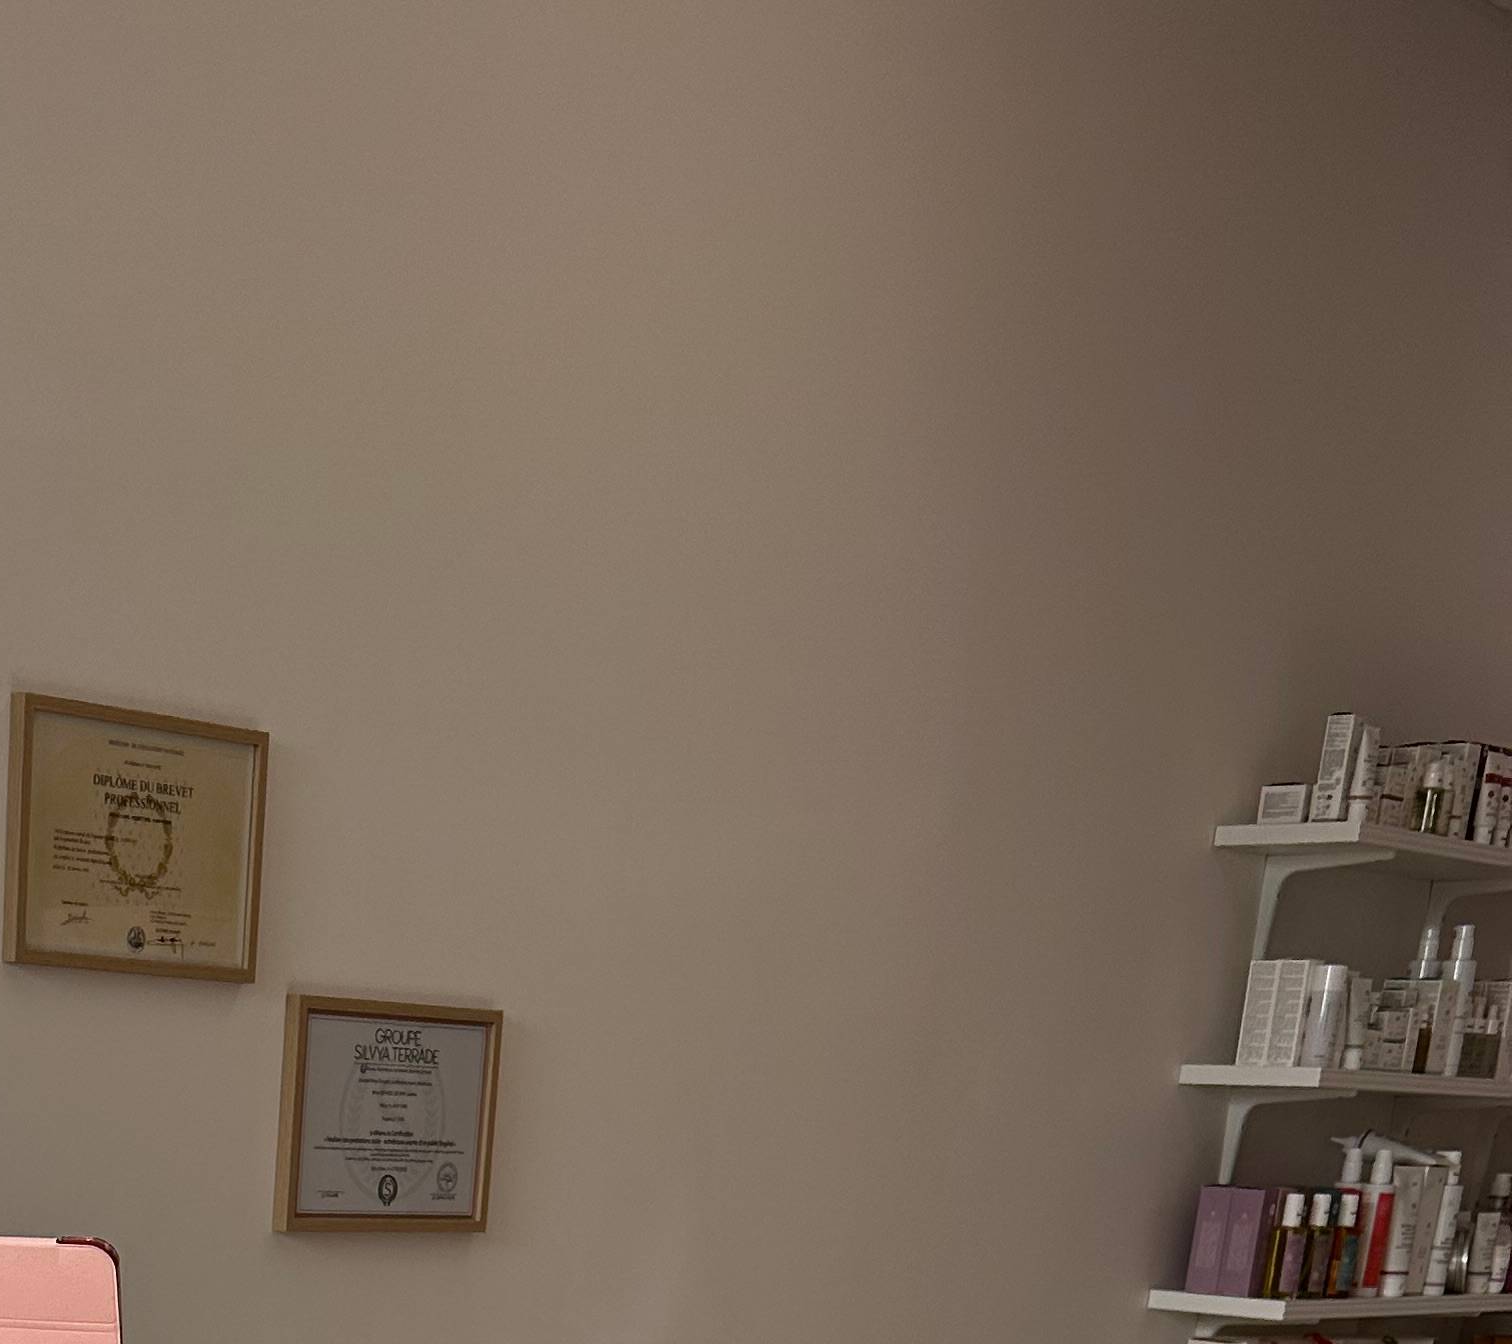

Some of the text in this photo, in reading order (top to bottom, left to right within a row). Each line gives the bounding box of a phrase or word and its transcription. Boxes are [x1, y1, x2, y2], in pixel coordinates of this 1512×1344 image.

[139, 780, 155, 794] DU
[155, 782, 194, 799] BREVET
[104, 792, 182, 815] PROFESSIONNEL
[375, 1028, 422, 1047] GROUPE
[391, 1046, 441, 1065] TERRADE
